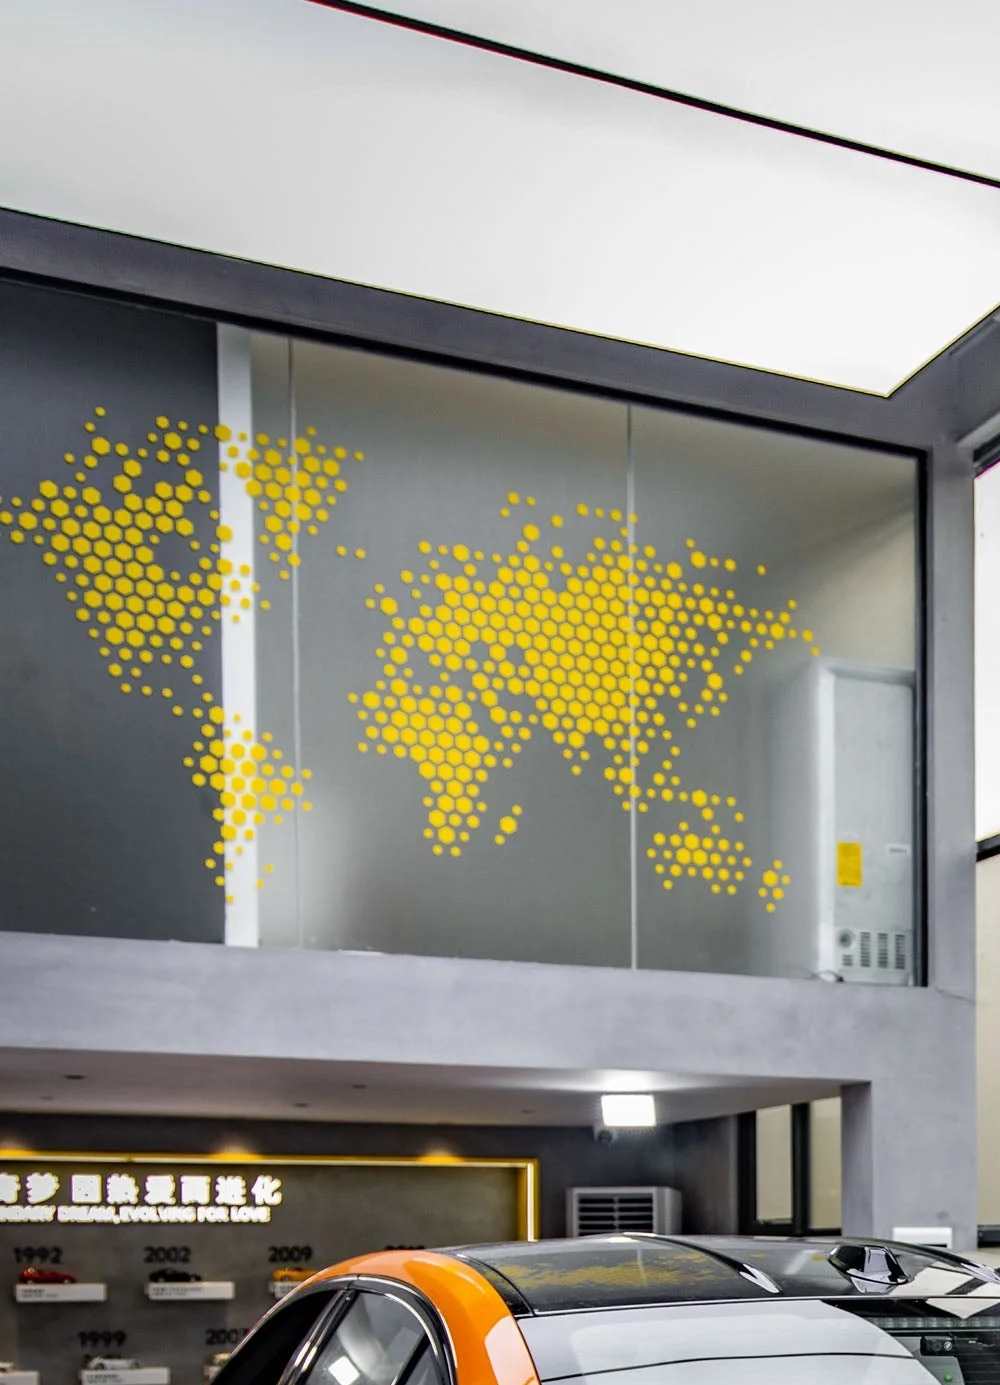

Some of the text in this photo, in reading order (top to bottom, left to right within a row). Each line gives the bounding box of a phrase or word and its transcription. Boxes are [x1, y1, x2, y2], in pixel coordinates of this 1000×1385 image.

[197, 1206, 229, 1222] FOR
[230, 1206, 270, 1222] LOVE
[14, 1246, 63, 1264] 1992
[144, 1246, 191, 1263] 2002
[268, 1246, 313, 1263] 2009
[78, 1330, 127, 1347] 1999
